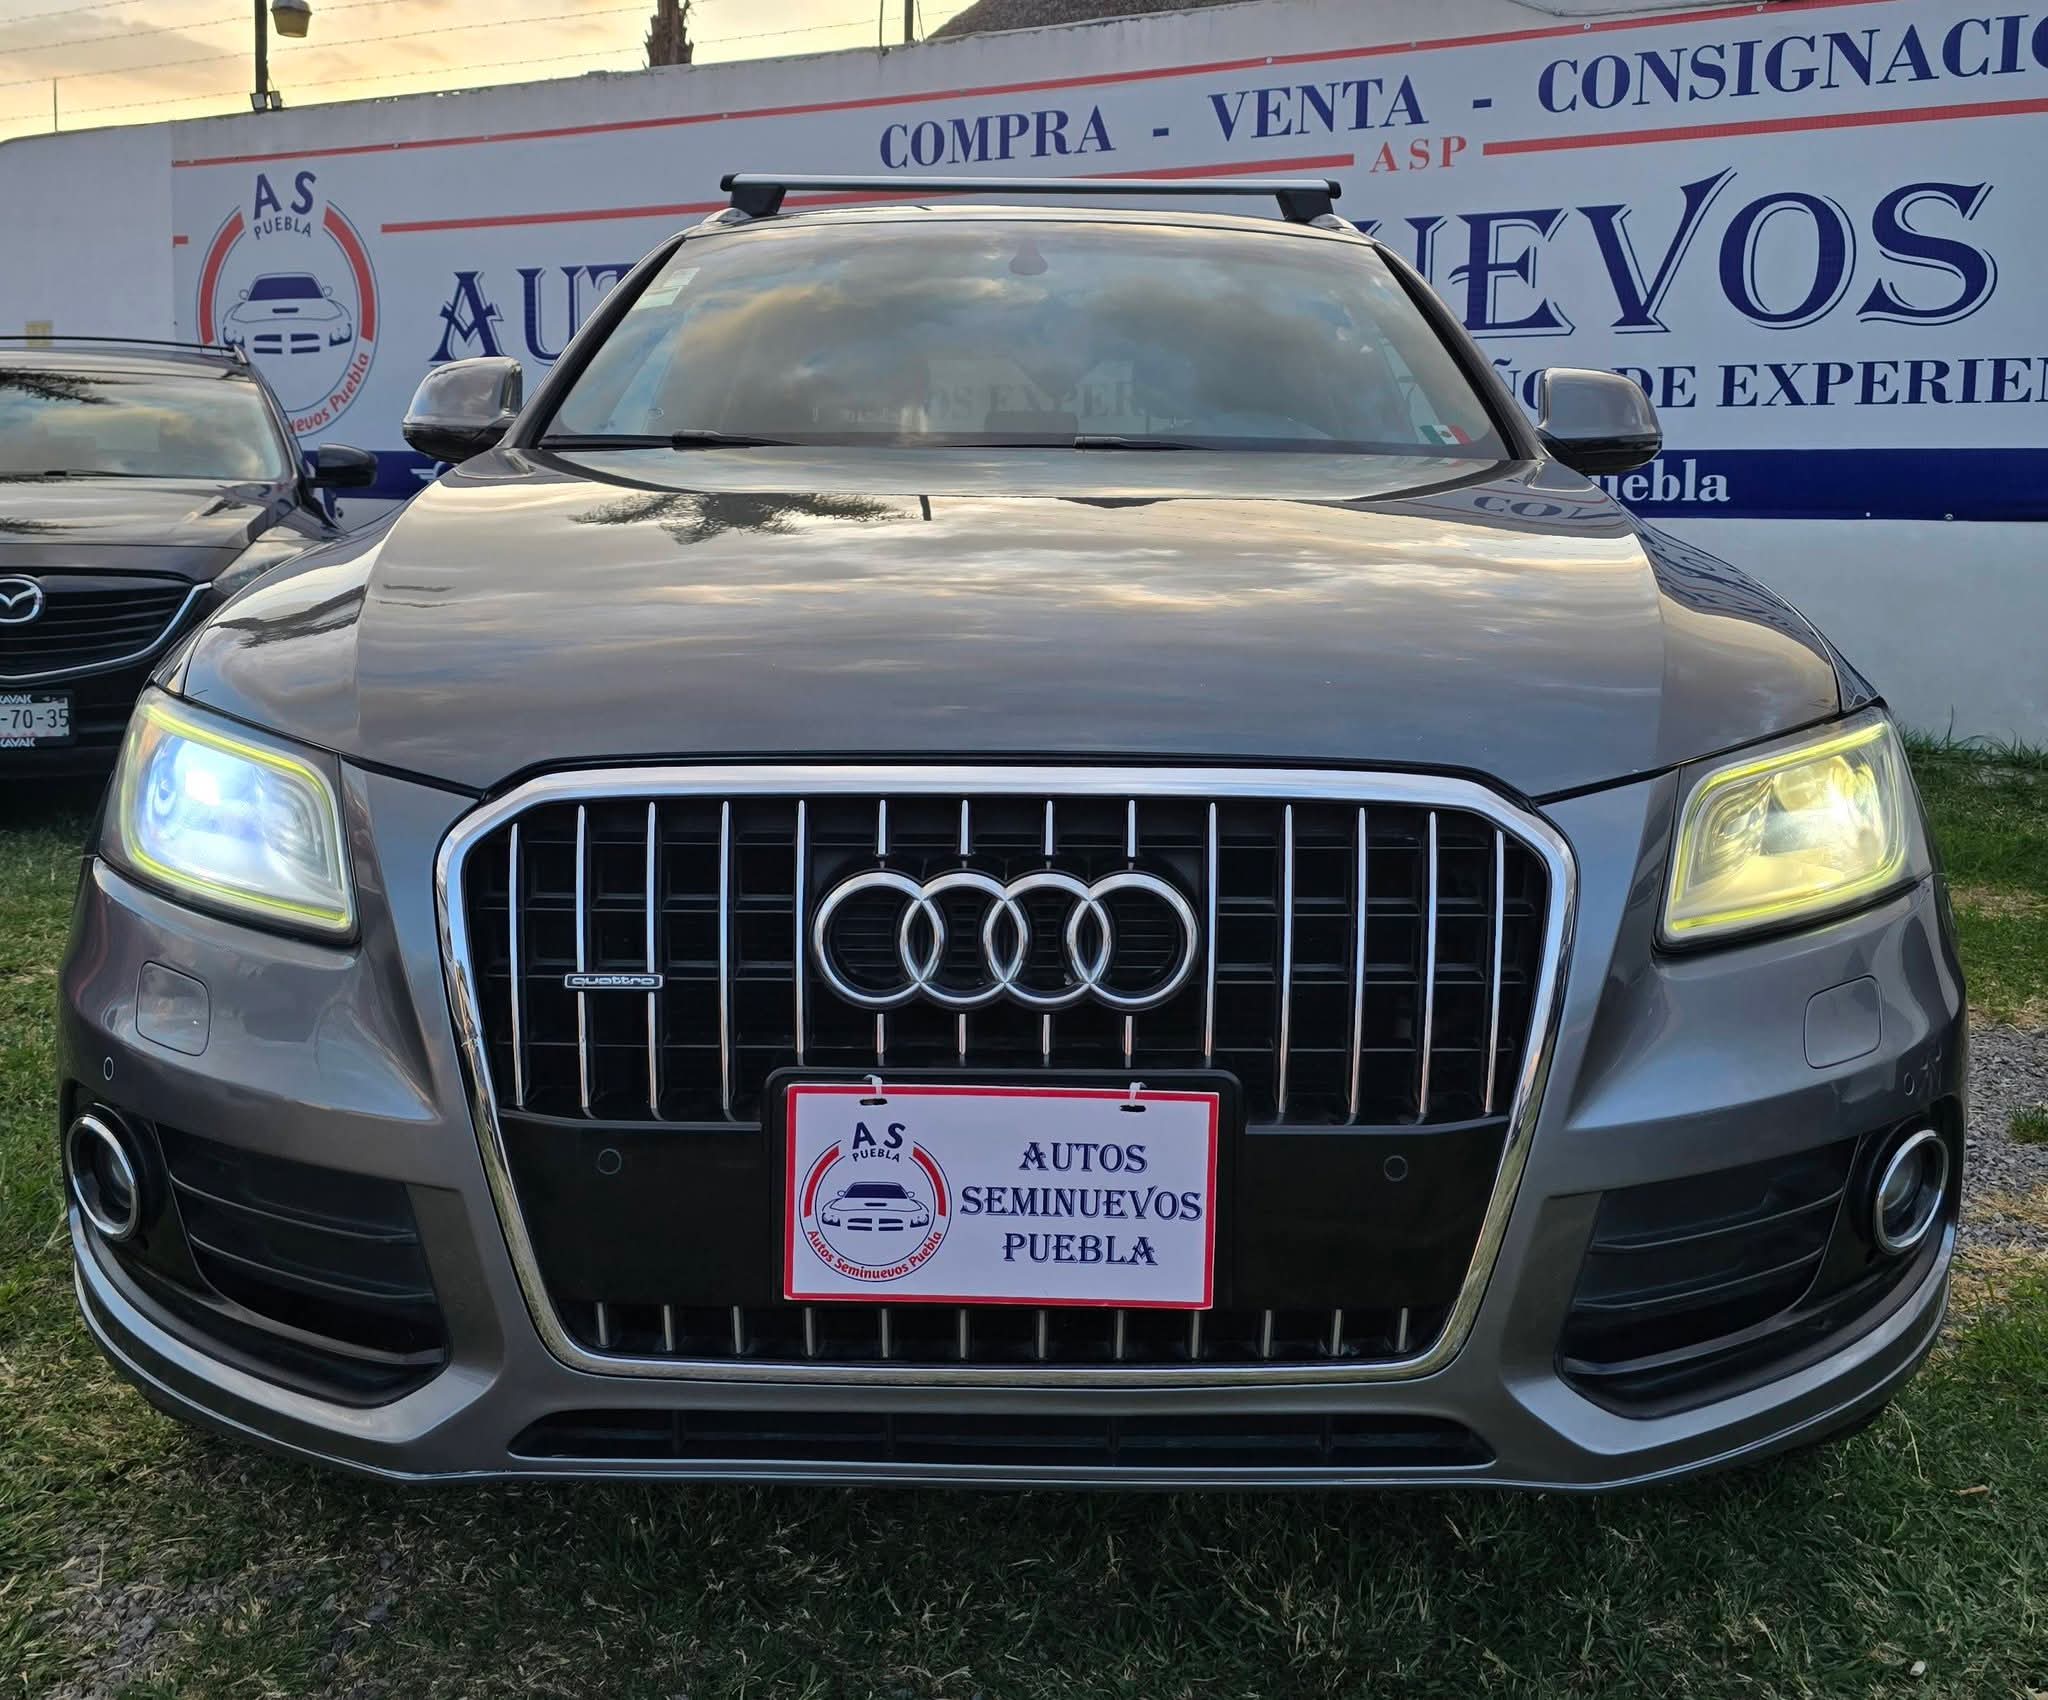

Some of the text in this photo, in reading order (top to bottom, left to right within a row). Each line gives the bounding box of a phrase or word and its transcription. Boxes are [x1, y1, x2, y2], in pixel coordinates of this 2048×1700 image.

[880, 105, 1116, 169] COMPRA
[1207, 74, 1430, 142] VENTA
[1369, 135, 1468, 174] ASP
[254, 216, 311, 240] PUEBLA
[329, 353, 369, 413] Puebla
[1717, 357, 2048, 409] EXPERIE
[571, 976, 655, 988] quattro
[852, 1148, 900, 1162] PUEBLA
[1019, 1141, 1148, 1173] AUTOS
[960, 1184, 1203, 1221] SEMINUEVOS
[807, 1230, 943, 1280] Autos Seminuevos Puebla
[1002, 1232, 1159, 1266] PUEBLA
